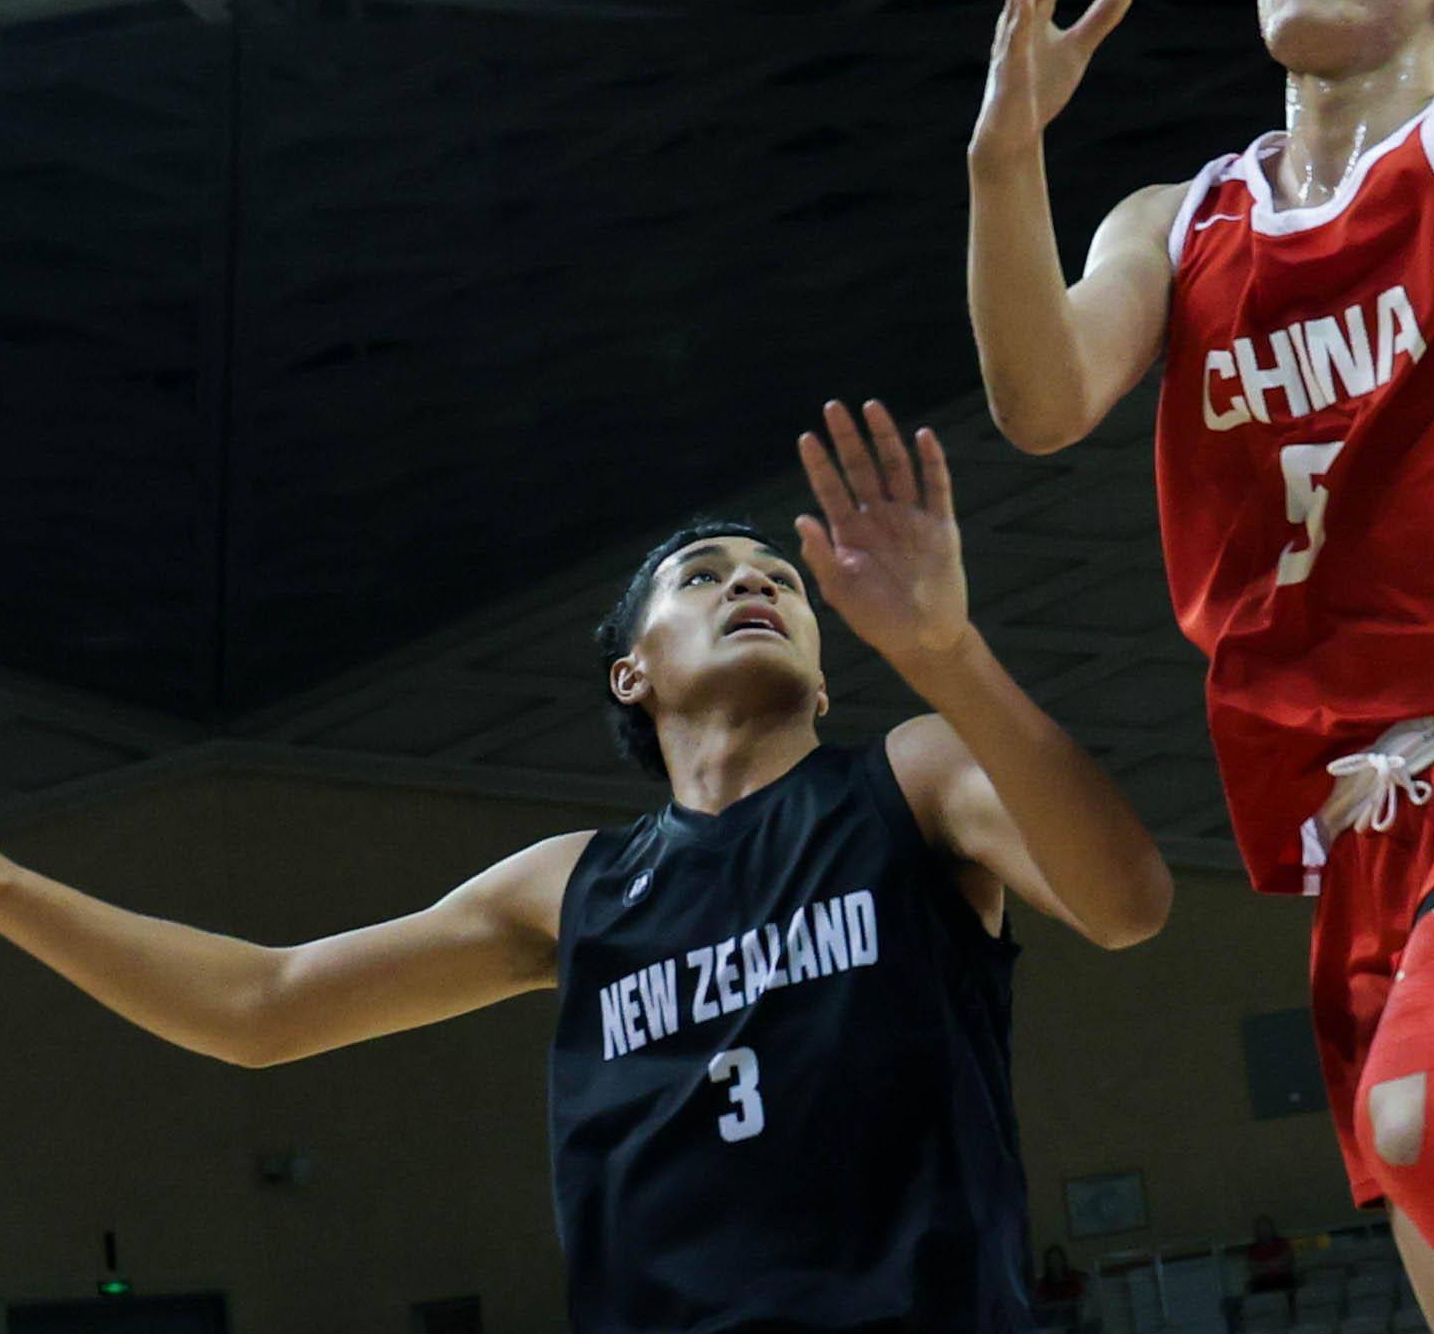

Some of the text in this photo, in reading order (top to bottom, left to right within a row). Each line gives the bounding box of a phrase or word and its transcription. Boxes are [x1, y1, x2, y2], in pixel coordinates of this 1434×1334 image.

[1203, 284, 1427, 432] CHINA
[1275, 440, 1347, 587] 5
[599, 889, 879, 1062] NEW ZEALAND
[708, 1045, 765, 1144] 3
